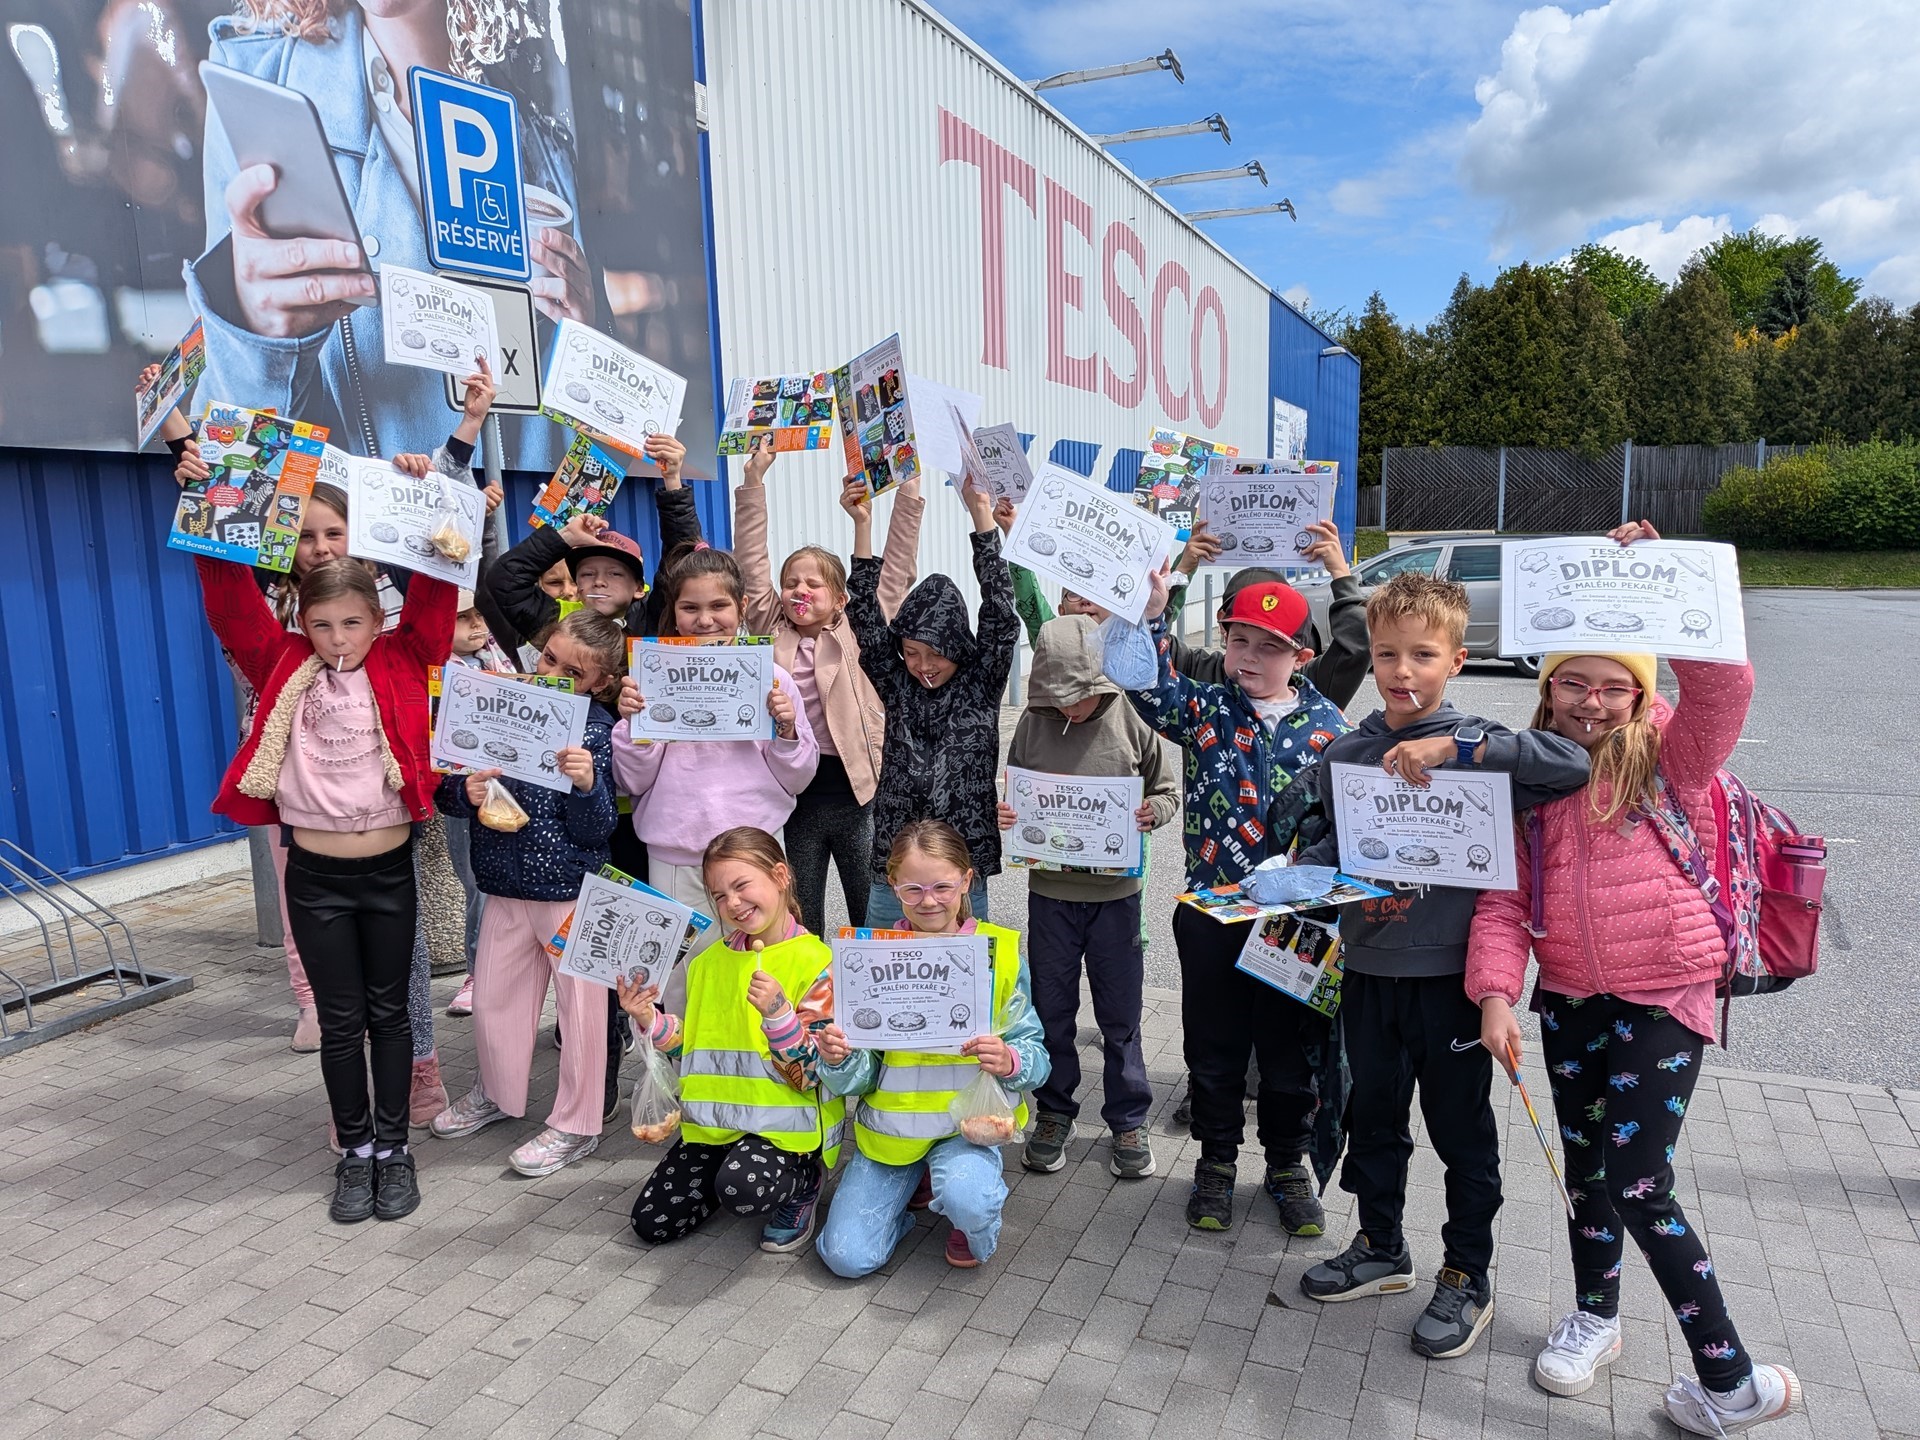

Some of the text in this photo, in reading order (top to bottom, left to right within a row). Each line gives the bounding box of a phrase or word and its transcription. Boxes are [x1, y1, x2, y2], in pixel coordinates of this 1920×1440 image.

[439, 100, 498, 208] P
[437, 218, 522, 256] RÉSERVÉ
[938, 104, 1228, 429] TESCO
[430, 285, 453, 297] TESCO
[415, 294, 472, 322] DIPLOM
[611, 351, 635, 369] TESCO
[592, 354, 653, 398] DIPLOM
[1090, 496, 1118, 515] TESCO
[1230, 494, 1298, 512] DIPLOM
[1065, 500, 1136, 548] DIPLOM
[1067, 522, 1094, 537] MALÉHO
[1094, 533, 1118, 551] PEKAŘE
[172, 537, 229, 555] Foil Scratch Art
[1590, 548, 1636, 557] TESCO
[1560, 559, 1678, 584] DIPLOM
[1575, 580, 1660, 592] MALÉHO PEKAŘE
[667, 667, 740, 685] DIPLOM
[497, 687, 527, 700] TESCO
[676, 684, 702, 692] MALÉHO
[476, 696, 549, 728] DIPLOM
[482, 714, 535, 733] MALÉHO PEKAŘE
[1200, 730, 1213, 744] TNT
[1236, 734, 1252, 746] TNT
[1054, 784, 1084, 792] TESCO
[1037, 794, 1108, 814] DIPLOM
[1373, 794, 1464, 818] DIPLOM
[1045, 810, 1096, 822] MALÉHO PEKAŘE
[1386, 814, 1452, 827] MALÉHO PEKAŘE
[1246, 823, 1262, 840] TNT
[1204, 842, 1214, 860] TNT
[579, 920, 592, 941] TESCO
[590, 908, 621, 960] DIPLOM
[890, 950, 923, 958] TESCO
[870, 962, 950, 984] DIPLOM
[880, 983, 938, 992] MALÉHO PEKAŘE
